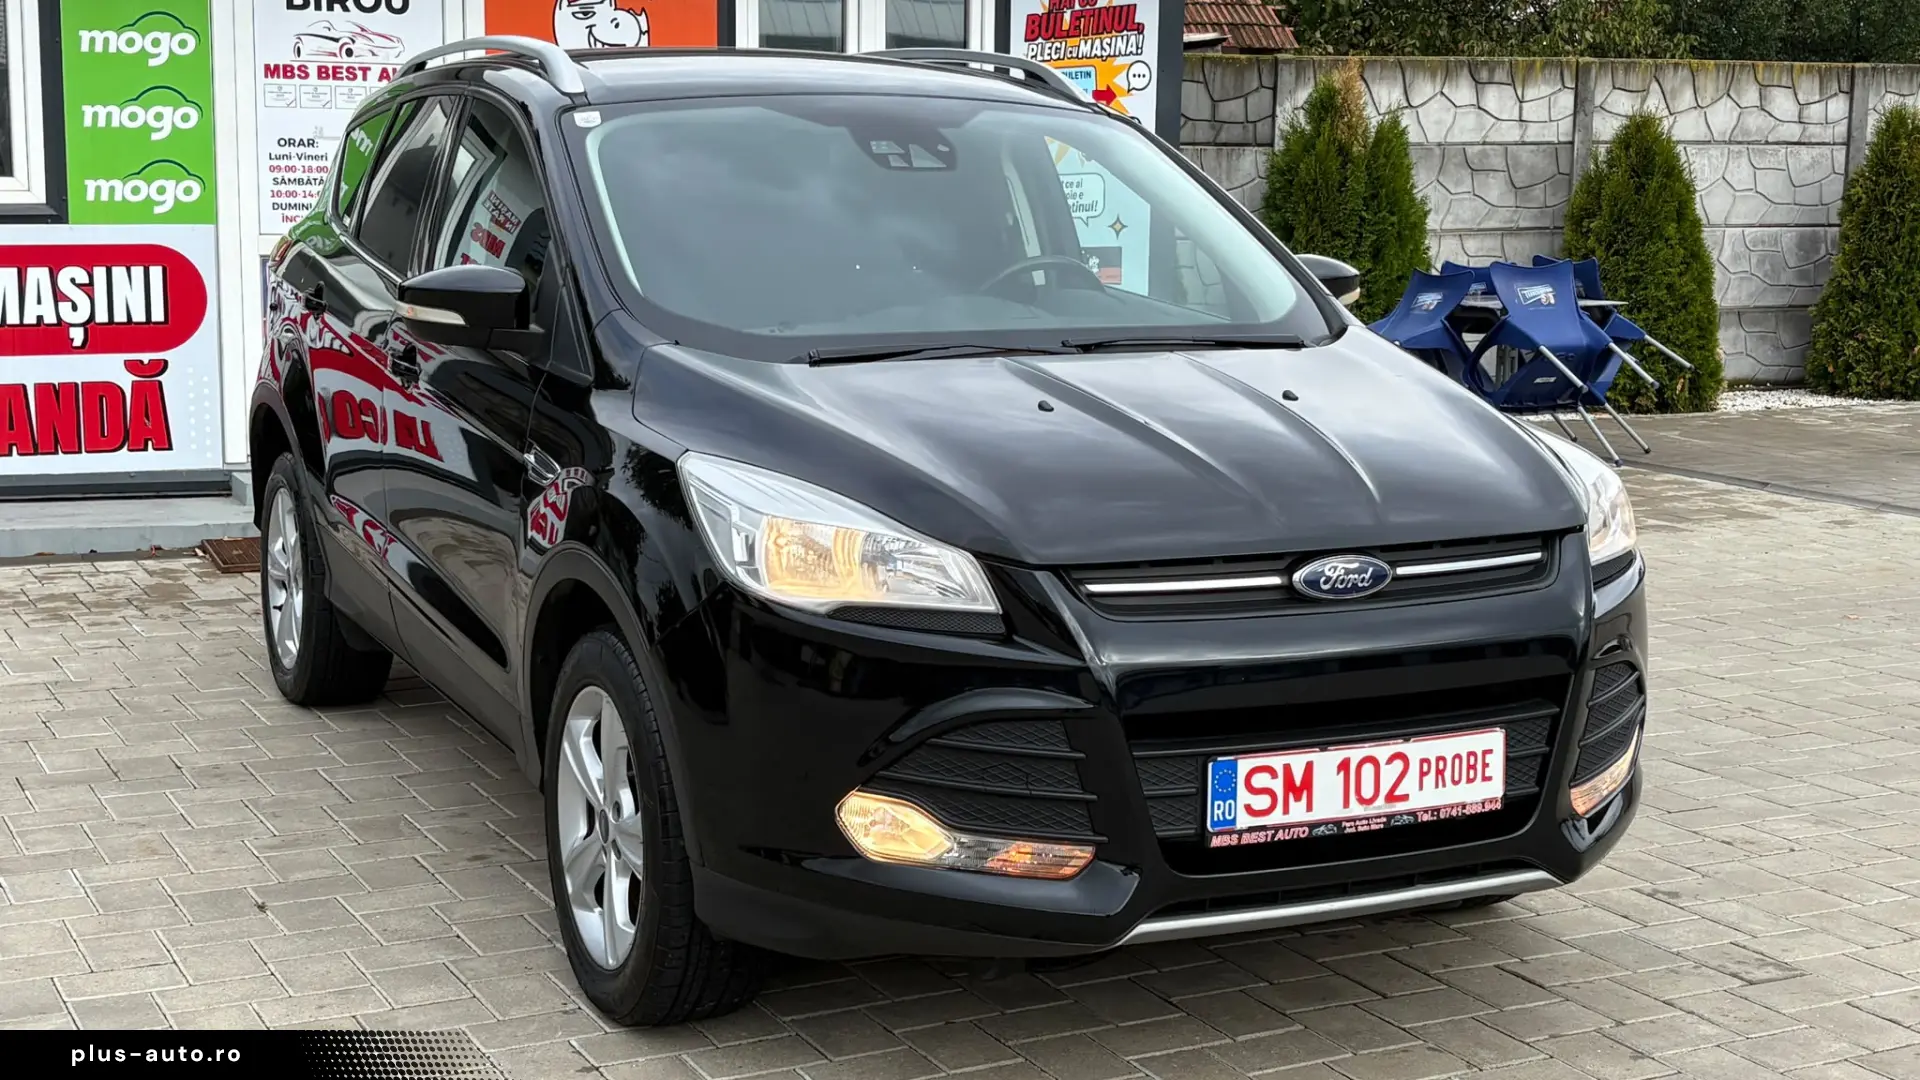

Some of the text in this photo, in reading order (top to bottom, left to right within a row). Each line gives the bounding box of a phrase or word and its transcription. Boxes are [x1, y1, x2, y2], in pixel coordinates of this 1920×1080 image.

[1024, 4, 1145, 42] BULETINUL,
[79, 29, 196, 67] mogo
[1028, 40, 1067, 61] PLECI
[1078, 33, 1144, 62] MAȘINA!
[264, 63, 397, 82] MBS BEST A
[81, 104, 199, 141] mogo
[269, 152, 328, 161] Luni-Vineri
[277, 138, 319, 148] ORAR:
[269, 164, 328, 174] 09:00-18:00
[84, 178, 201, 215] mogo
[0, 265, 168, 349] MAȘINI
[1320, 562, 1373, 590] Ford
[1244, 749, 1494, 818] SM 102 PROBE
[1213, 800, 1235, 821] RO
[1211, 826, 1309, 848] MBS BEST AUTO
